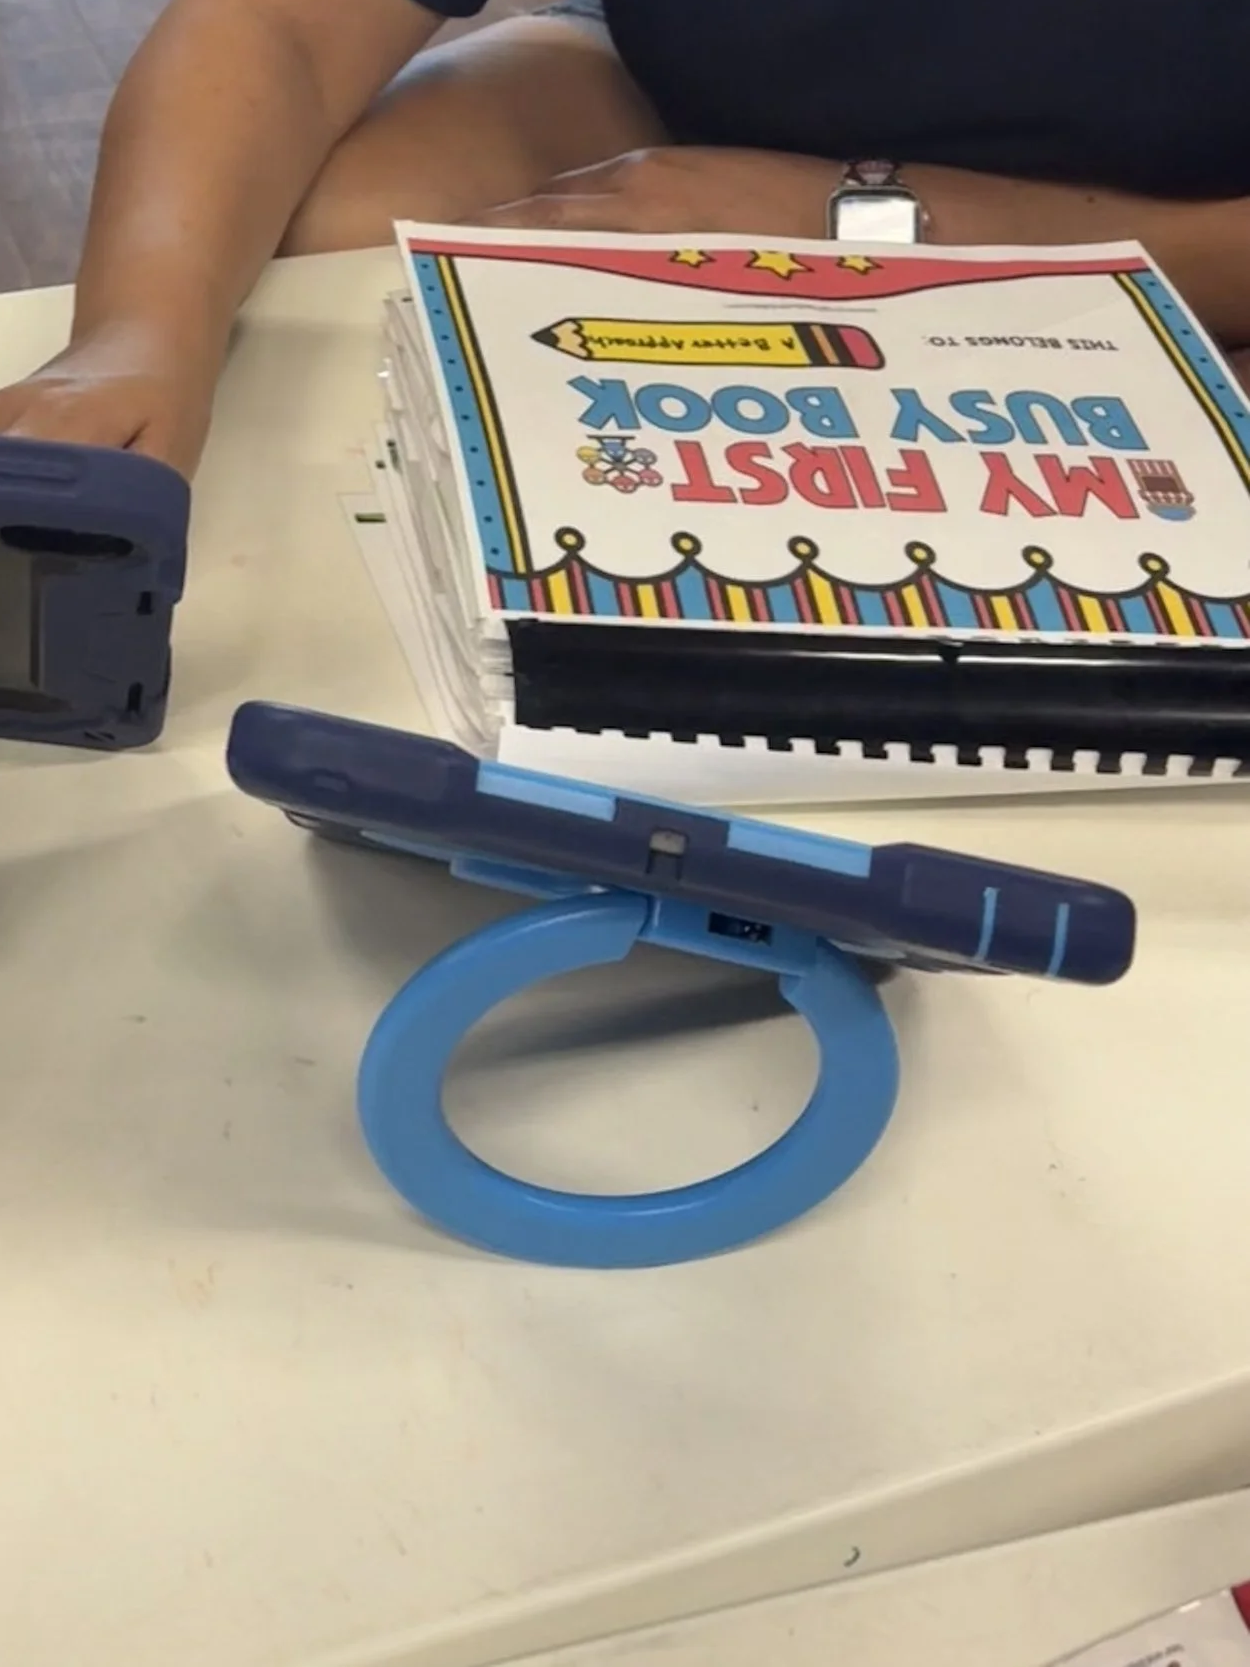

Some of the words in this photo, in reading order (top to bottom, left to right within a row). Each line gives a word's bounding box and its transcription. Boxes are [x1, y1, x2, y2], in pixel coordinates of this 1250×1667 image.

[587, 333, 685, 350] Approach
[692, 336, 770, 352] Better
[779, 337, 796, 352] A
[964, 335, 1063, 351] BELONGS
[1067, 337, 1119, 352] THIS
[567, 375, 860, 439] BOOK
[889, 387, 1150, 451] BUSY
[671, 439, 947, 513] FIRST
[979, 451, 1140, 520] MY
